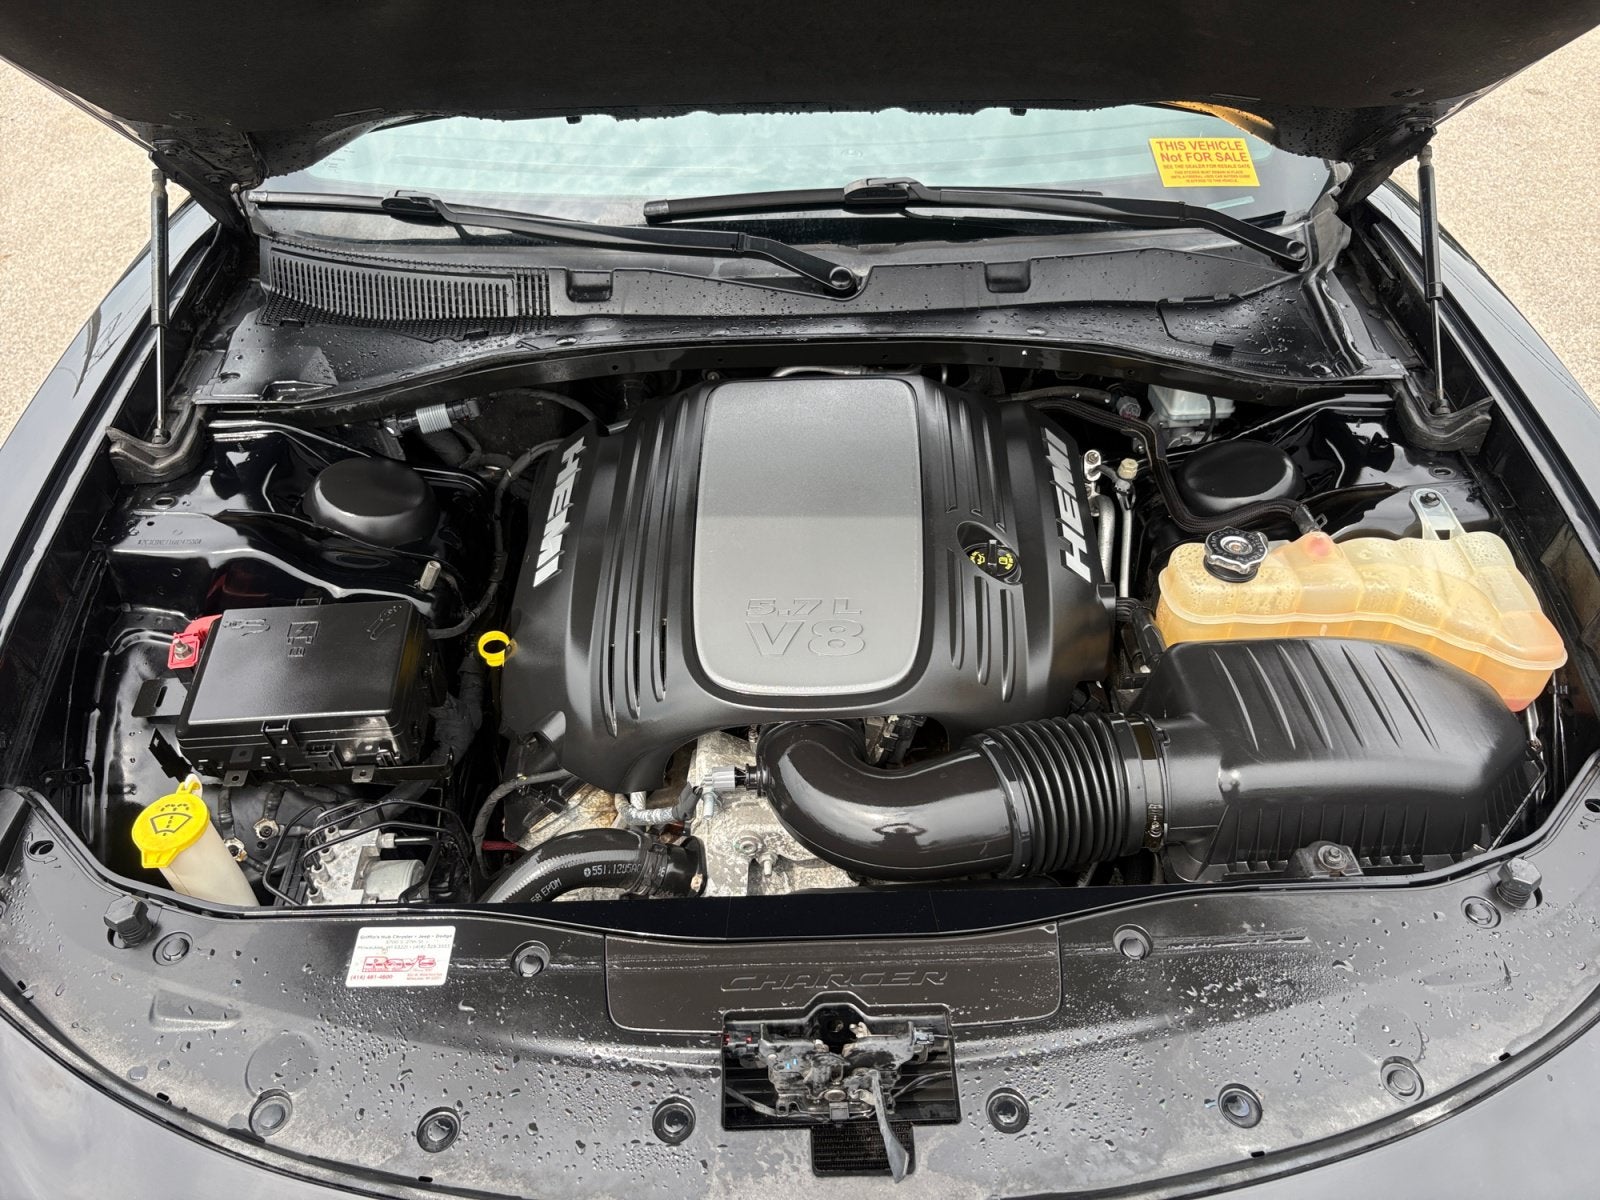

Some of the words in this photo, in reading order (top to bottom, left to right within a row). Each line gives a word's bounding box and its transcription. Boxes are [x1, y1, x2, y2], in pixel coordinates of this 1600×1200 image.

[1156, 141, 1187, 152] THIS
[1188, 140, 1244, 151] VEHICLE
[1160, 152, 1183, 162] Not
[1185, 152, 1213, 162] FOR
[1215, 152, 1249, 162] SALE
[533, 436, 585, 588] HEMI
[1045, 427, 1091, 583] HEMI
[745, 619, 866, 656] V8
[720, 971, 948, 992] CHARGER
